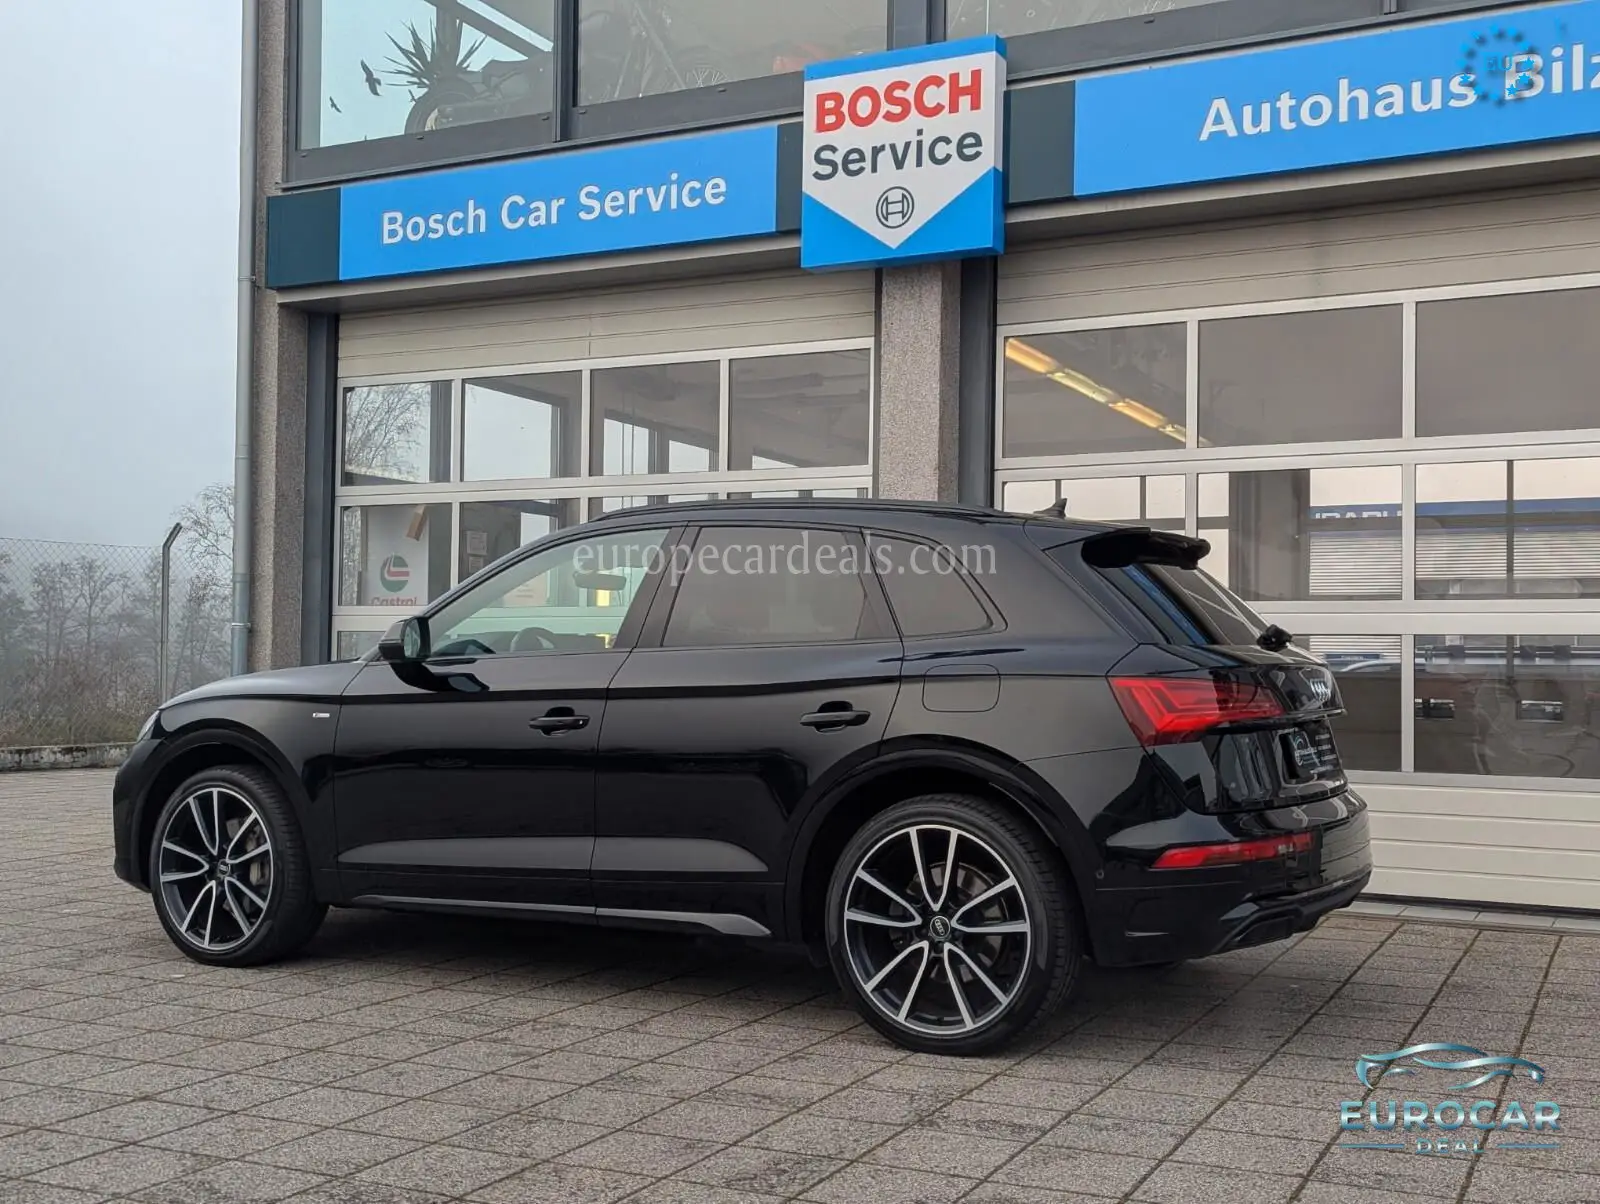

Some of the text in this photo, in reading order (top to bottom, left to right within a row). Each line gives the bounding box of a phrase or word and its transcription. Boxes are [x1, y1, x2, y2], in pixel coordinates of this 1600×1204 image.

[815, 69, 982, 133] BOSCH
[1199, 72, 1478, 142] Autohaus
[812, 128, 983, 181] Service
[382, 172, 727, 244] Bosch Car Service
